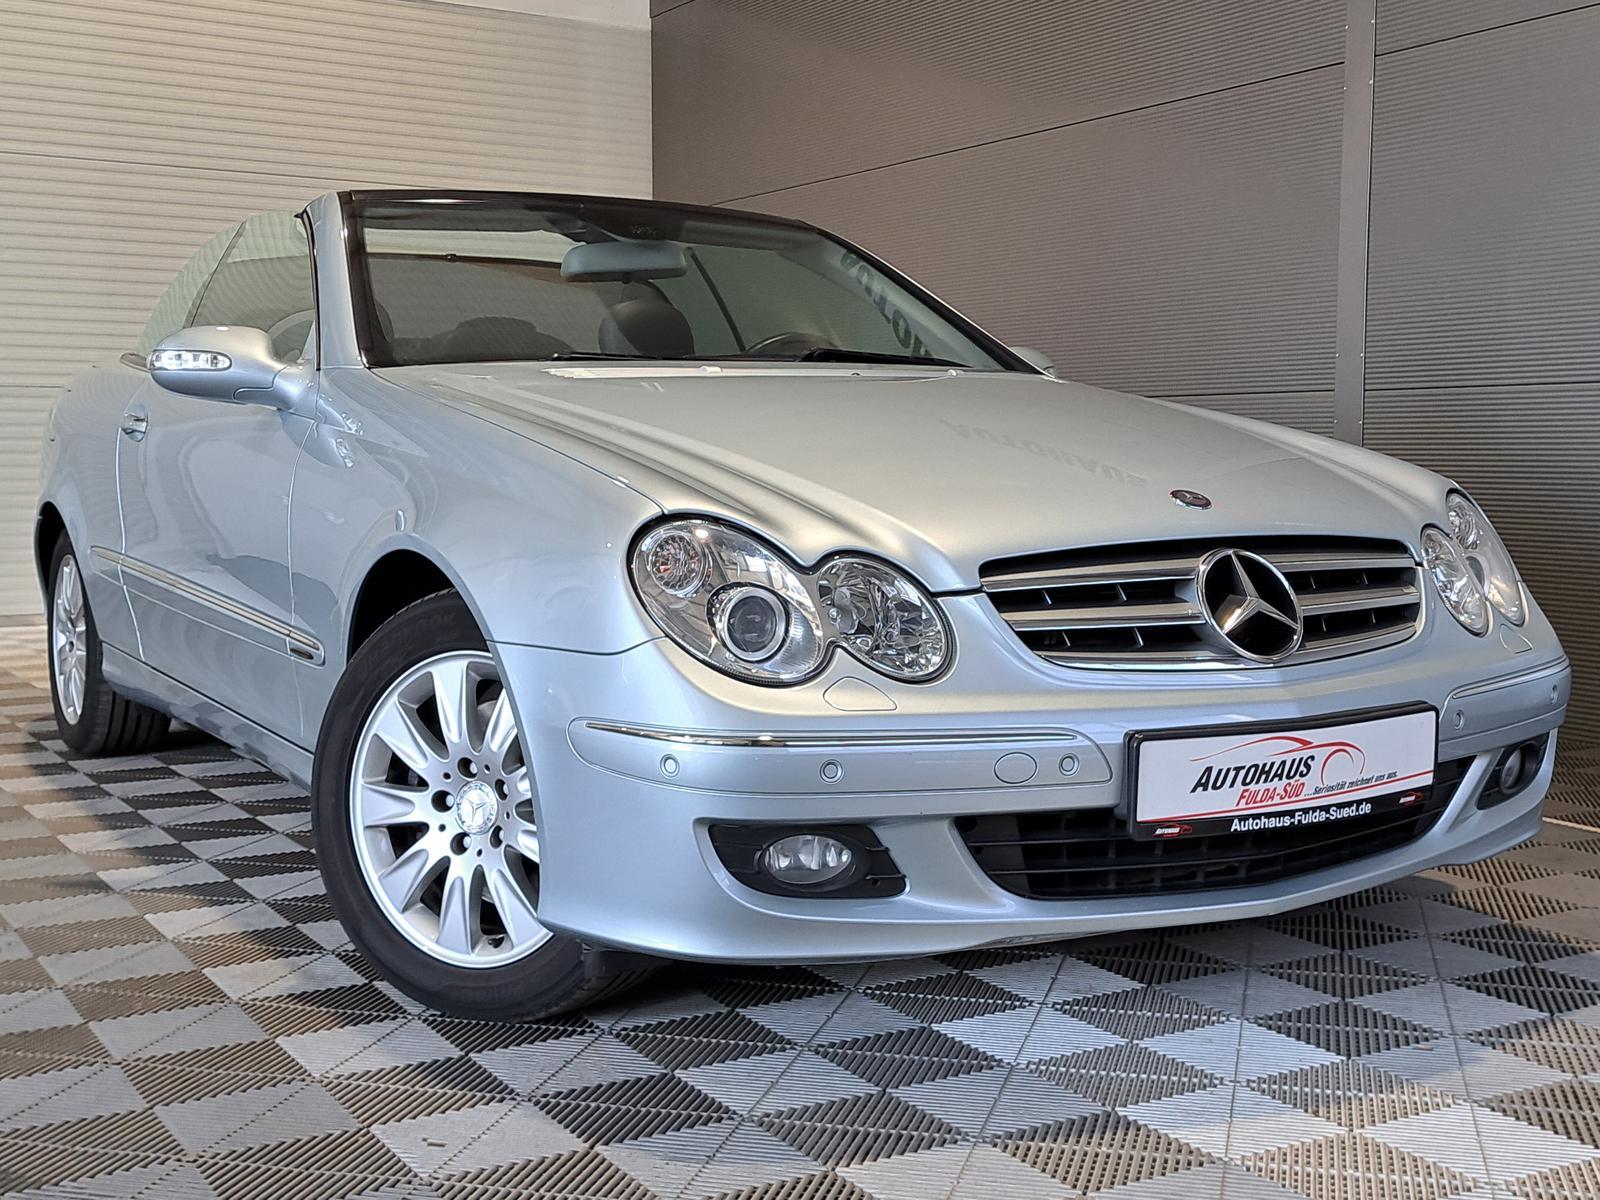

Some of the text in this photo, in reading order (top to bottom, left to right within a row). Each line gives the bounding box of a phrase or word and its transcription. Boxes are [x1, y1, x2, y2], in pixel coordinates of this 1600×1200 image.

[1189, 755, 1315, 793] AUTOHAUS
[1235, 779, 1305, 807] FULDA-SÜD
[1230, 801, 1372, 832] Autohaus-Fulda-Sued.de
